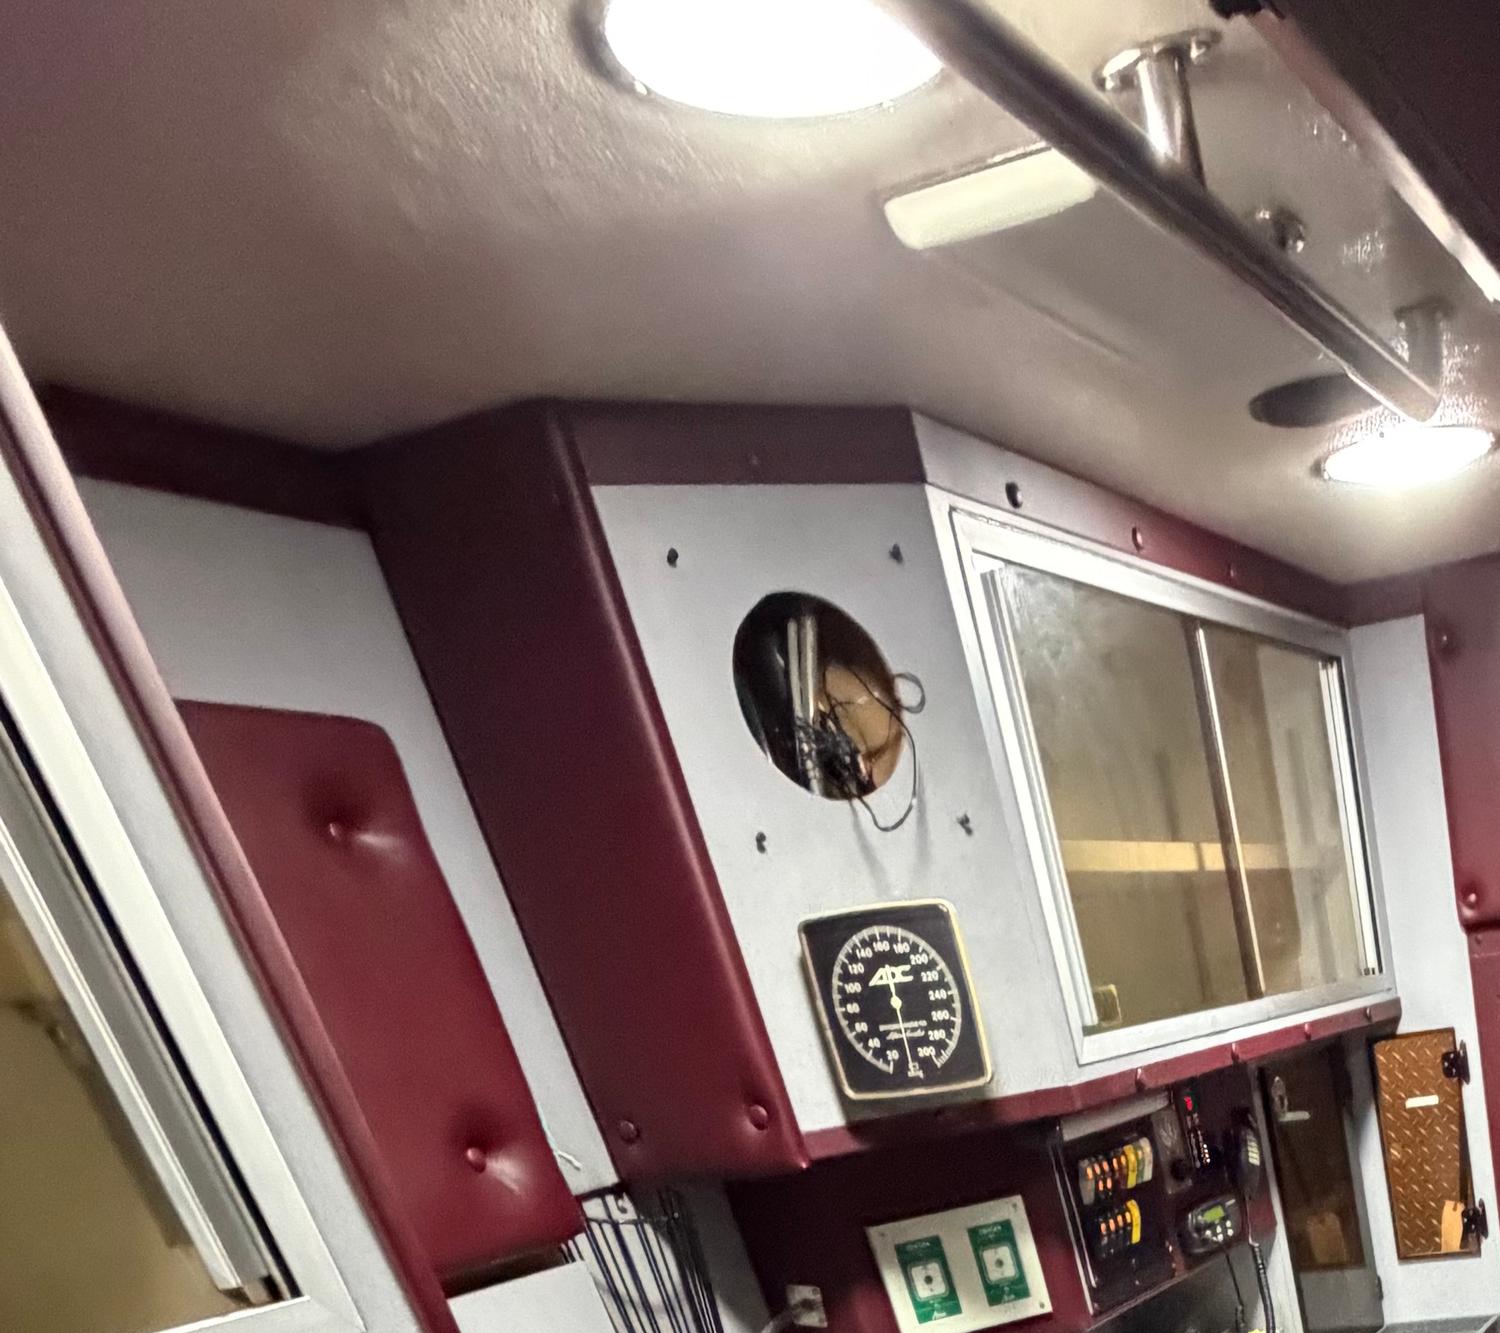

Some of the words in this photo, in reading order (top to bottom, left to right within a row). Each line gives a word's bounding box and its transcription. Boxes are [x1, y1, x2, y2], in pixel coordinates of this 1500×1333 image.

[856, 947, 873, 960] 140
[909, 953, 929, 965] 200
[848, 963, 865, 975] 120
[868, 964, 914, 987] ADC
[920, 970, 939, 982] 220
[844, 982, 862, 994] 100
[928, 989, 947, 1001] 240
[930, 1009, 950, 1022] 260
[928, 1029, 946, 1041] 280
[868, 1037, 881, 1048] 40
